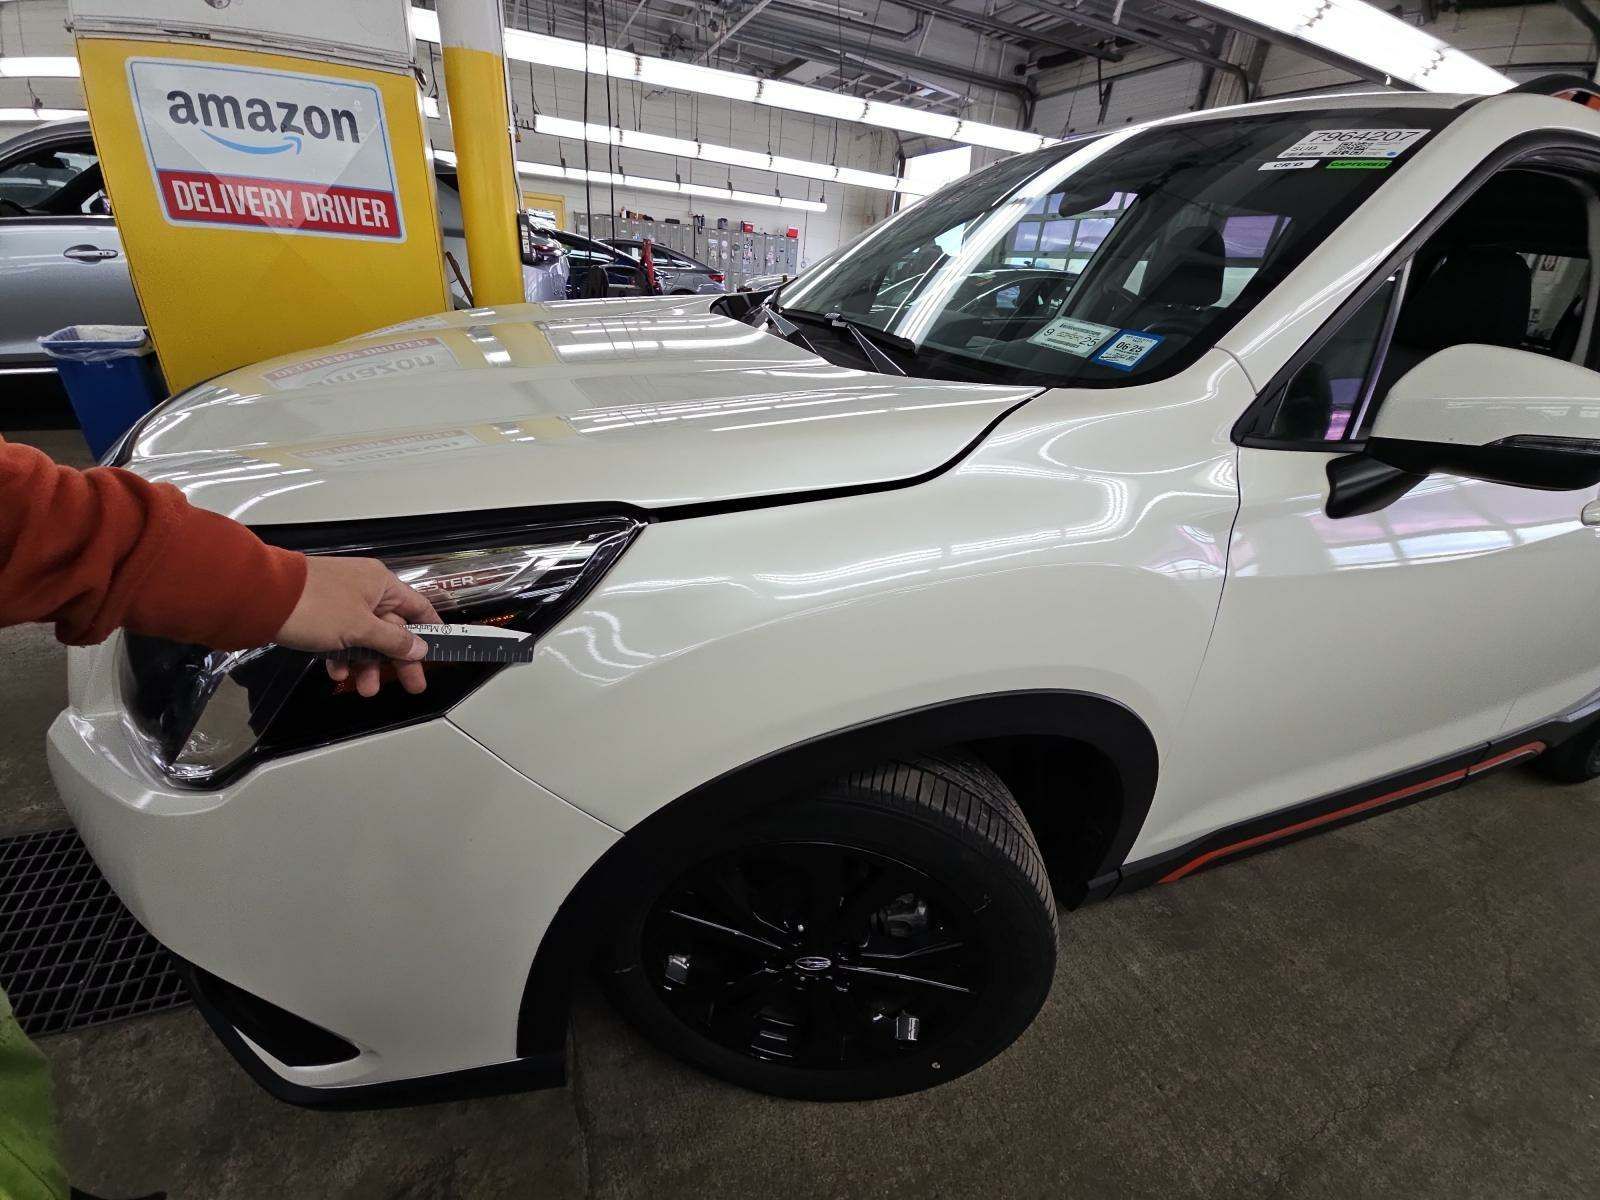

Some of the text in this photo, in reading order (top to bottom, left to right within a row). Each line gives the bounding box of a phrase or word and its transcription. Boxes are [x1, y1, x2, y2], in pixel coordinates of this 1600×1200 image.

[166, 89, 360, 144] amazon
[1311, 130, 1420, 143] 7964207
[171, 179, 390, 229] DELIVERY DRIVER
[1079, 335, 1100, 347] 25
[1115, 340, 1129, 351] 06
[1129, 343, 1145, 354] 25
[413, 575, 474, 592] ESTER
